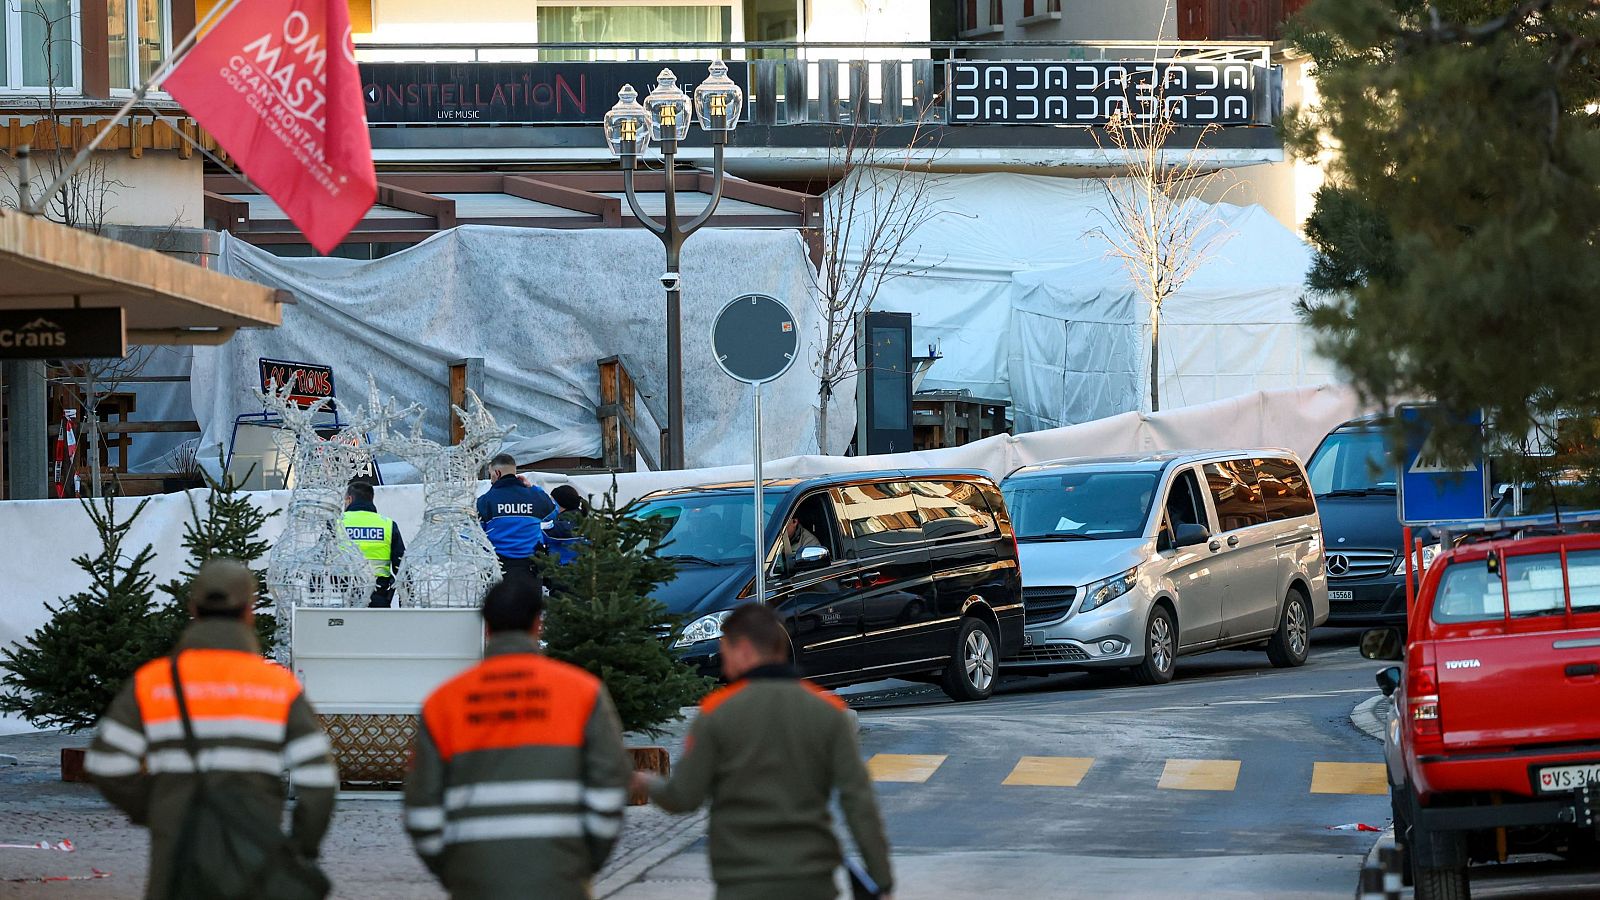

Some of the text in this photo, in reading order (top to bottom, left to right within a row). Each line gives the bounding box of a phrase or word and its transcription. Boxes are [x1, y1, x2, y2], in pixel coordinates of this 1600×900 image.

[220, 67, 248, 93] GOLF
[229, 55, 275, 106] CRANS
[437, 110, 480, 119] LIVE MUSIC
[0, 329, 66, 347] Crans
[497, 503, 533, 514] POLICE
[1445, 659, 1480, 669] TOYOTA
